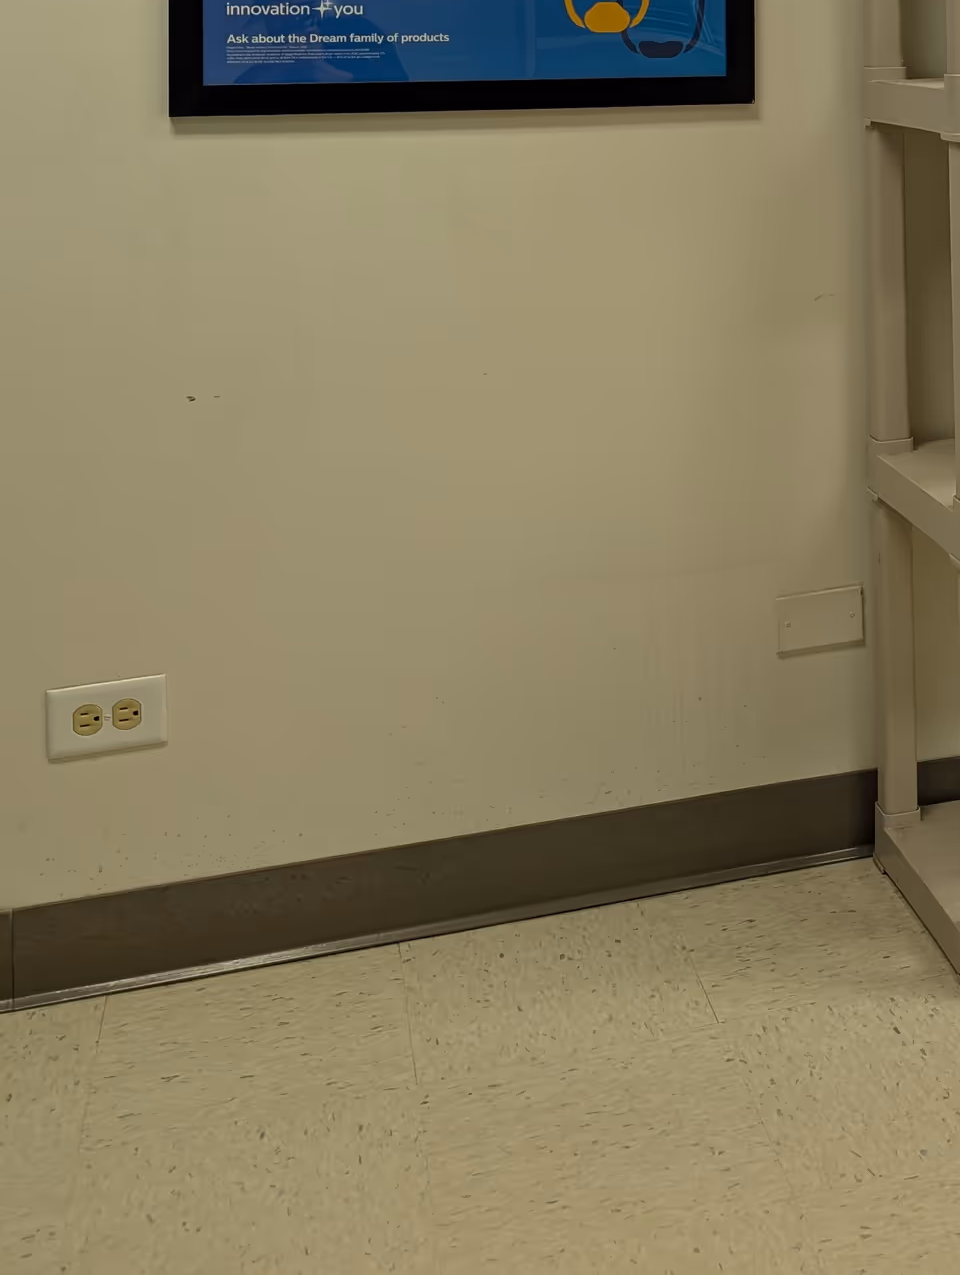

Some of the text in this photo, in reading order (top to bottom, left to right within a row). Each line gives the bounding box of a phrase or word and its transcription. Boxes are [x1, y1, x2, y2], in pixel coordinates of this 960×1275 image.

[226, 1, 364, 19] innovation you
[226, 32, 450, 45] Ask about the Dream family of products
